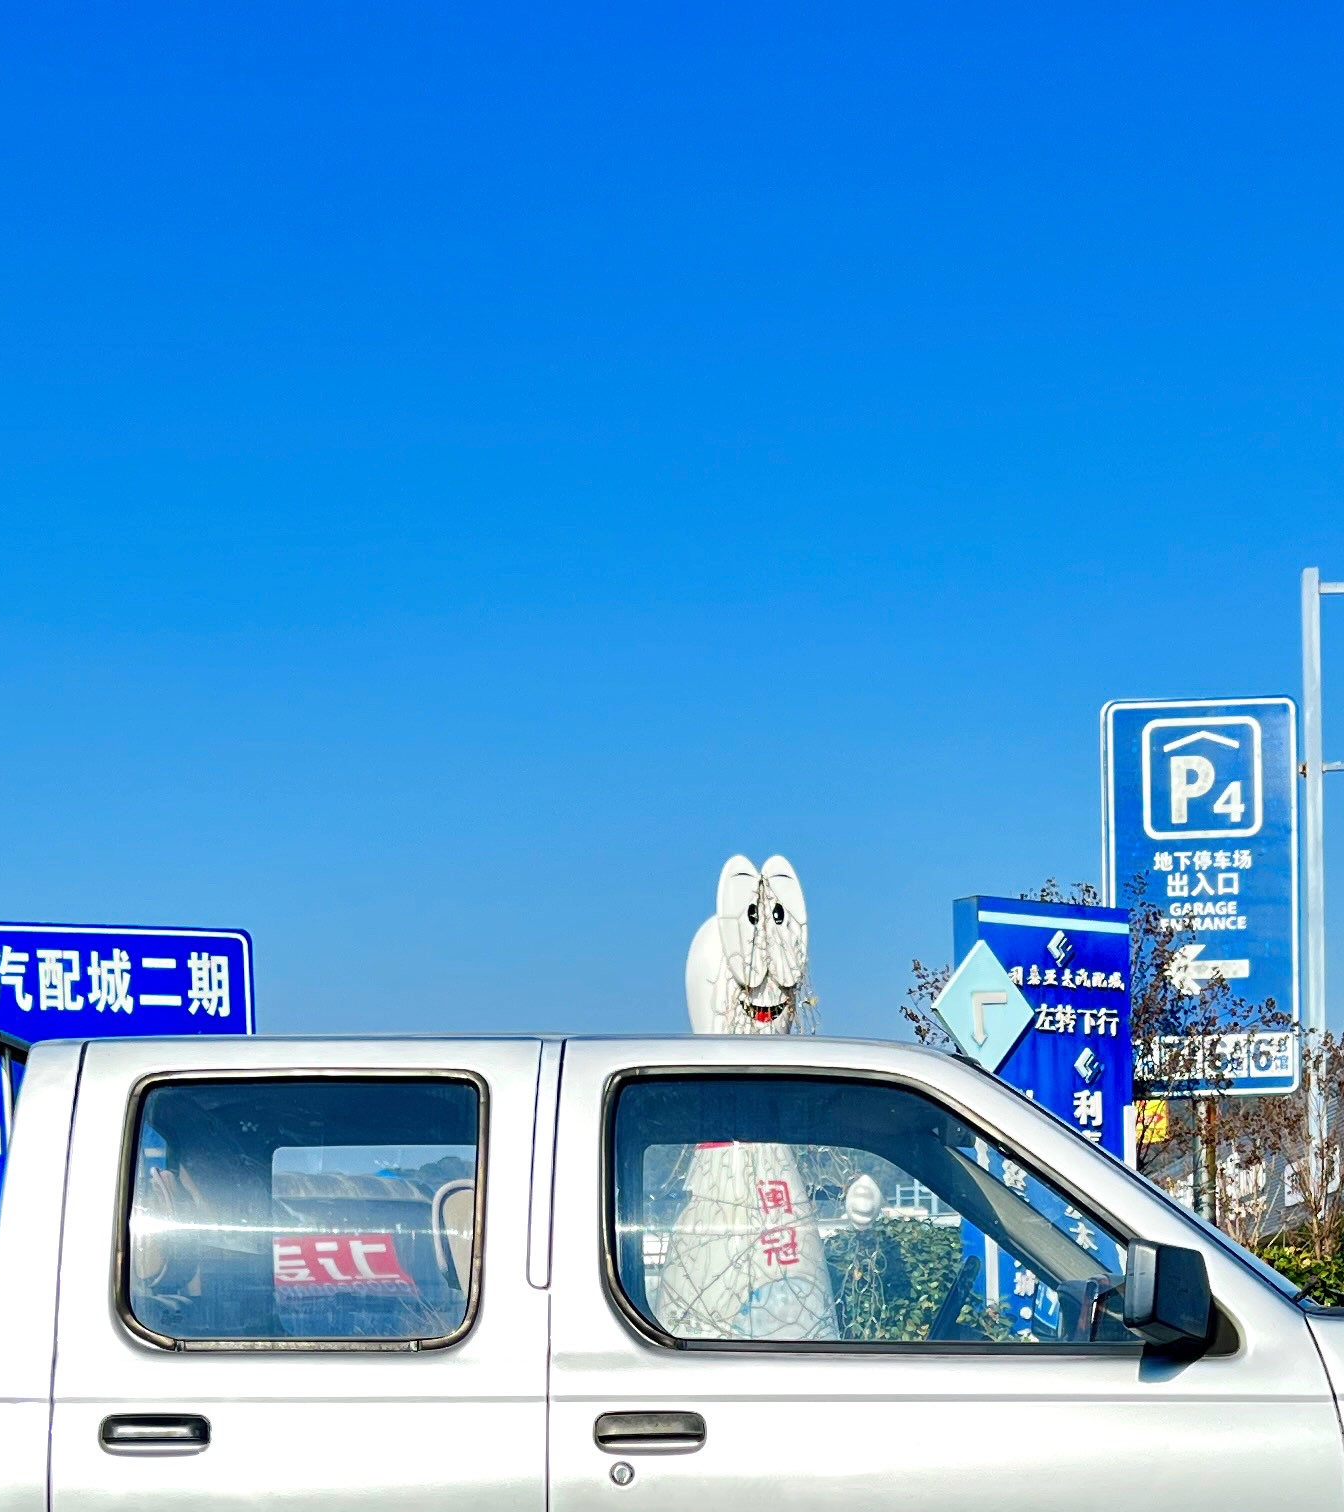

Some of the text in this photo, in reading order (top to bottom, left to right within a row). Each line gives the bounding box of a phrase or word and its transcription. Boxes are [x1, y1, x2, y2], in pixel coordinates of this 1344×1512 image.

[1170, 756, 1245, 824] P4
[1154, 850, 1252, 872] 地下停车场
[1167, 872, 1239, 897] 出入口
[1169, 901, 1237, 916] GARAGE
[1035, 1003, 1119, 1037] 左转下行
[758, 1180, 800, 1266] 闽冠
